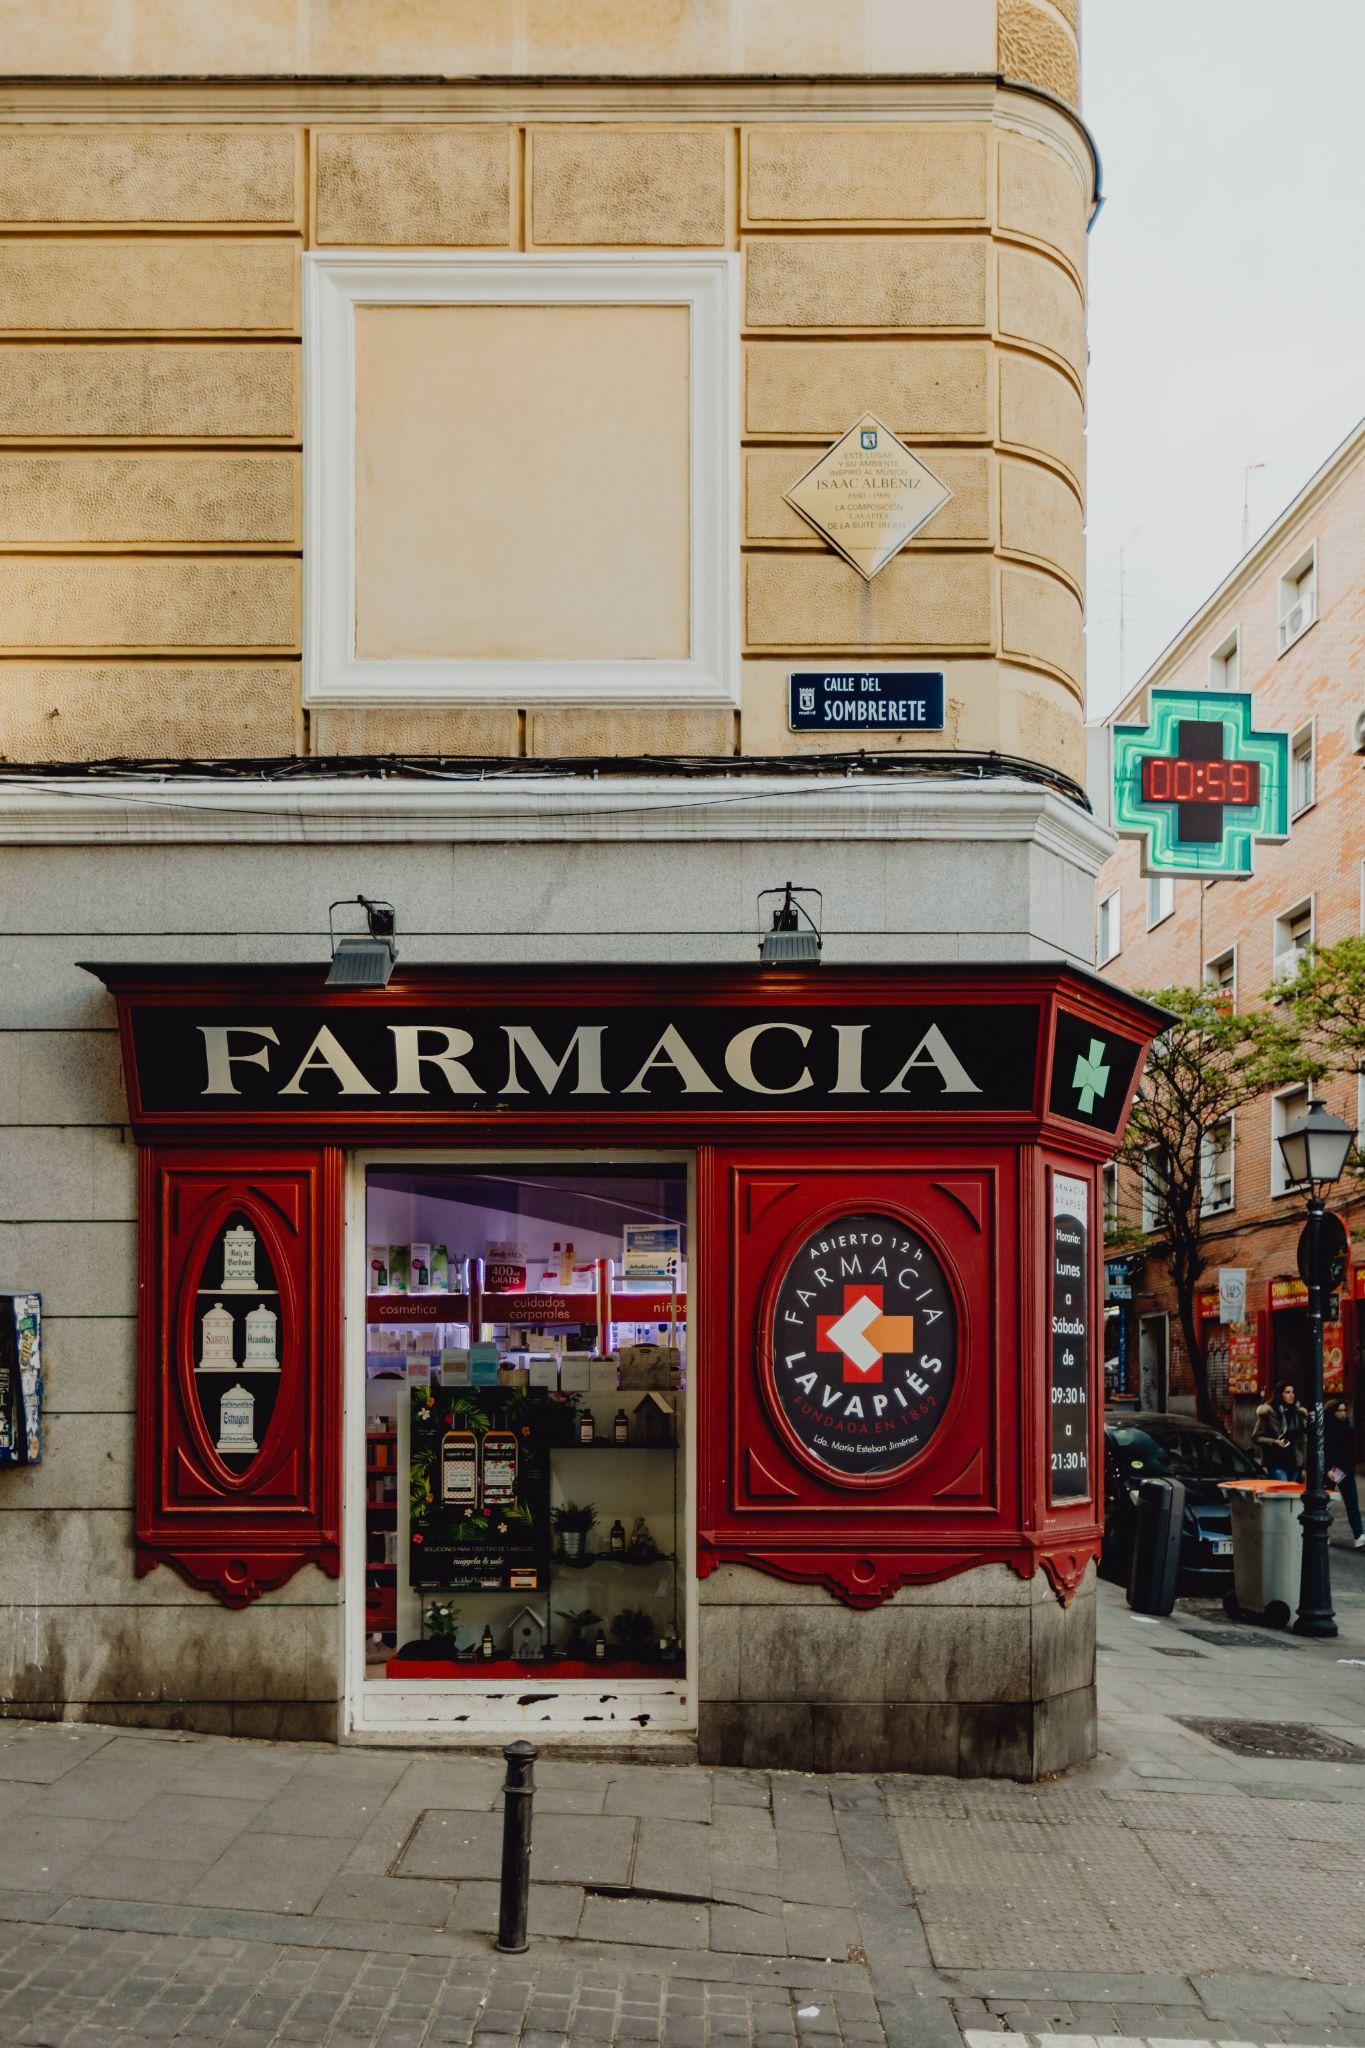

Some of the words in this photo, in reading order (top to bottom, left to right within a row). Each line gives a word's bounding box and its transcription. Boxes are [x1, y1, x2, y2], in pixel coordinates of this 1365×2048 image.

[859, 460, 899, 468] AMBIENTE
[816, 479, 859, 491] ISAAC
[835, 504, 845, 512] LA
[827, 522, 839, 530] DE
[824, 677, 855, 692] CALLE
[861, 677, 882, 692] DEL
[824, 700, 926, 721] SOMBRERETE
[1150, 760, 1250, 802] 00:59
[196, 1022, 983, 1095] FARMACIA
[1056, 1229, 1081, 1245] Horario:
[808, 1233, 883, 1260] ABIERTO
[891, 1237, 910, 1254] 12
[914, 1248, 924, 1261] h
[1056, 1258, 1081, 1278] Lunes
[491, 1276, 520, 1285] GRATIS
[784, 1254, 944, 1326] FARMACIA
[379, 1301, 437, 1315] cosmética
[513, 1296, 566, 1308] cuidados
[653, 1302, 688, 1313] niños
[1065, 1293, 1072, 1306] a
[509, 1305, 570, 1320] corporales
[1052, 1316, 1085, 1336] Sábado
[1062, 1347, 1074, 1367] de
[785, 1351, 943, 1418] LAVAPIÉS
[1051, 1387, 1078, 1405] 09:30
[1079, 1387, 1086, 1404] h
[793, 1396, 869, 1434] FUNDADA
[874, 1419, 896, 1434] EN
[901, 1396, 939, 1426] 1852
[1065, 1424, 1072, 1437] a
[813, 1434, 830, 1448] Lda.
[831, 1439, 855, 1453] María
[856, 1443, 887, 1454] Esteban
[888, 1434, 920, 1452] Jiménez
[1051, 1451, 1078, 1471] 21:30
[1079, 1451, 1087, 1468] h
